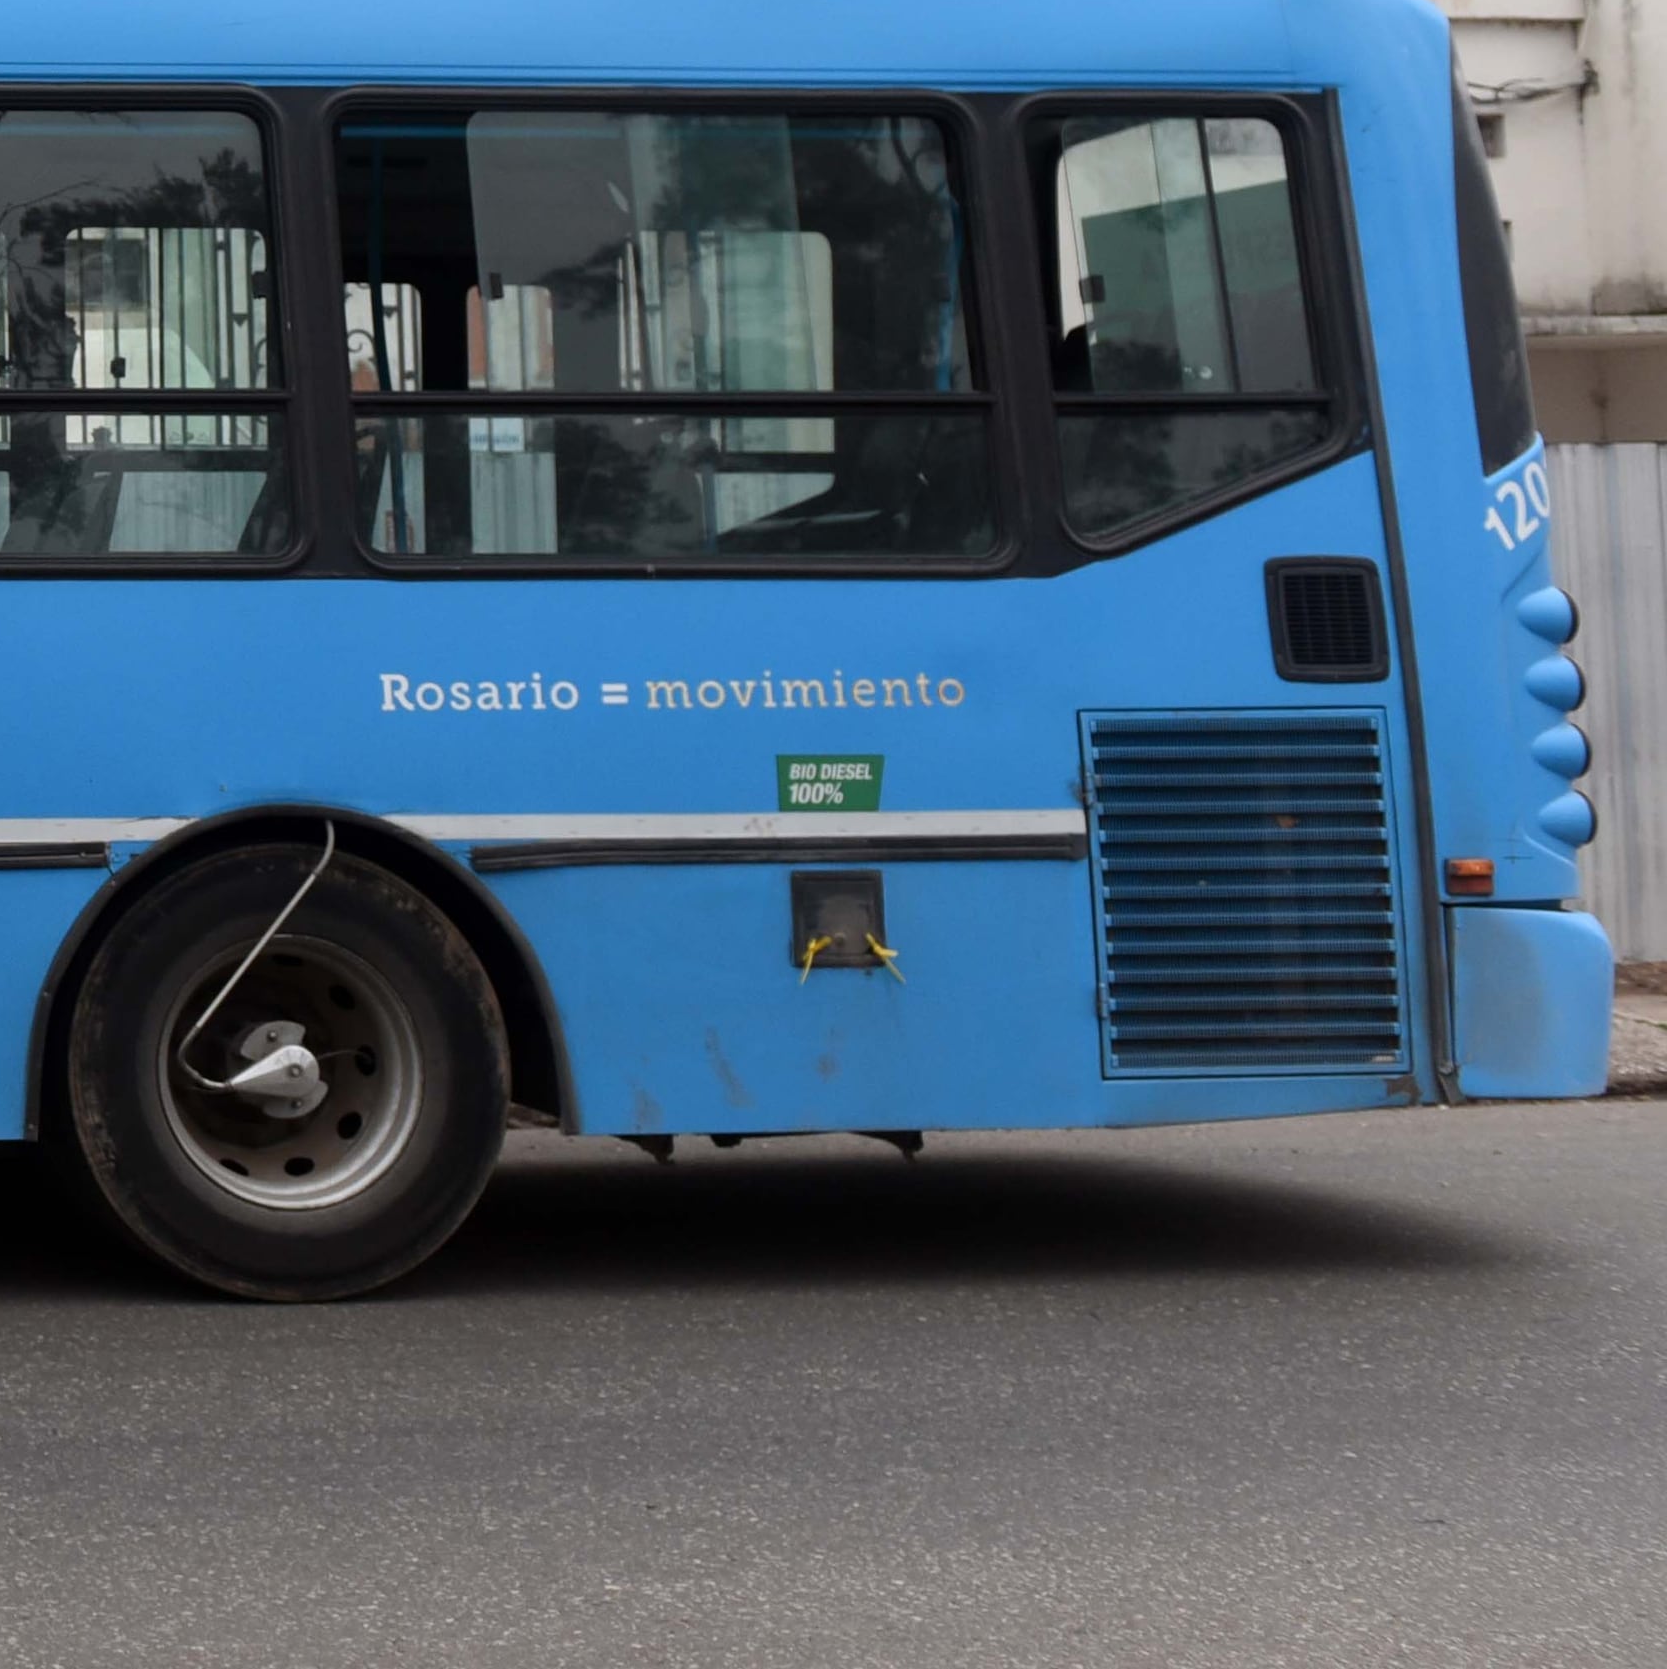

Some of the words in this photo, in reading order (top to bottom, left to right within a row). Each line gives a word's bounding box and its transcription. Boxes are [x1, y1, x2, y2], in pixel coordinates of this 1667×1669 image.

[1484, 461, 1550, 550] 120
[379, 672, 579, 711] Rosario
[645, 670, 965, 709] movimiento
[789, 763, 817, 780] BIO
[820, 763, 873, 780] DIESEL
[789, 782, 843, 805] 100%
